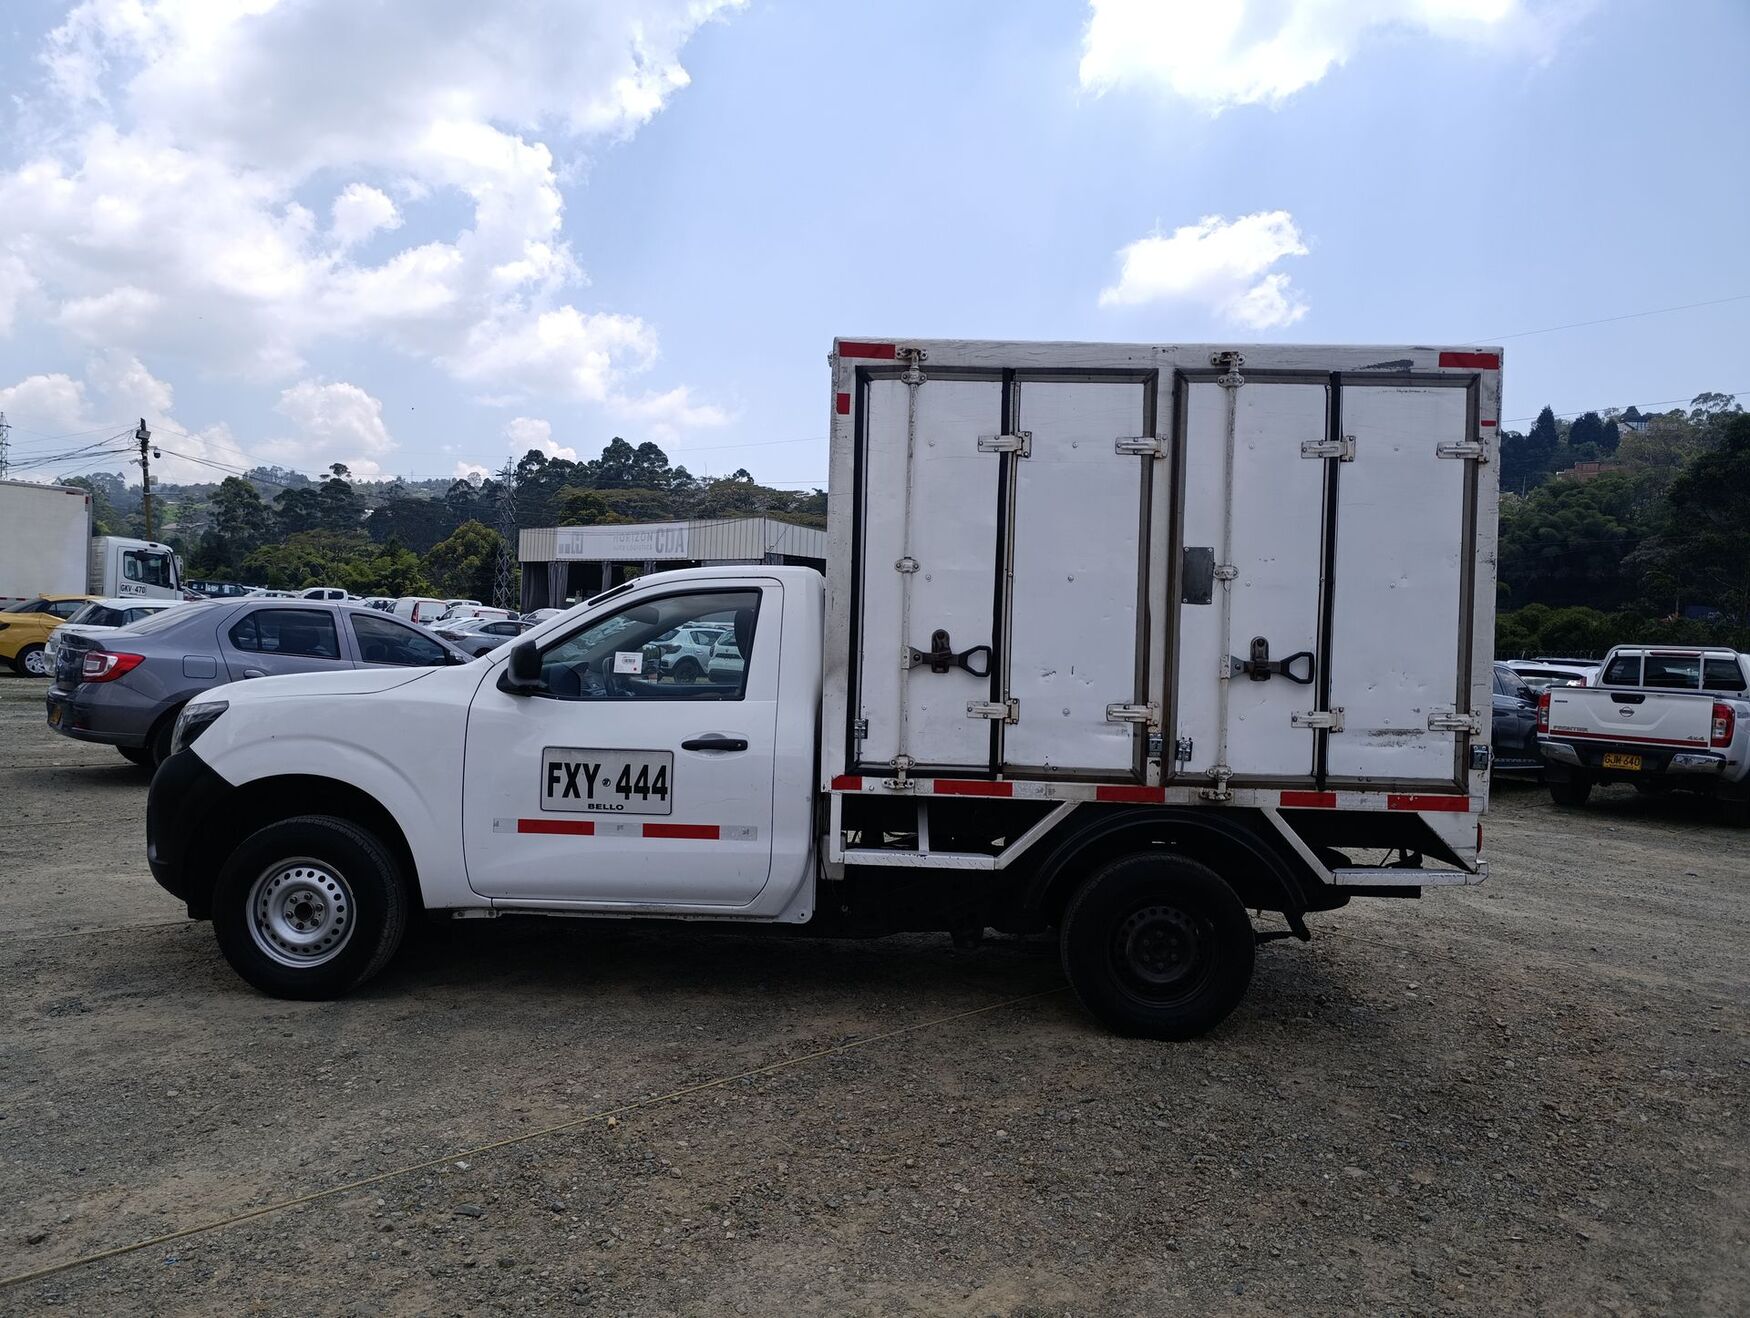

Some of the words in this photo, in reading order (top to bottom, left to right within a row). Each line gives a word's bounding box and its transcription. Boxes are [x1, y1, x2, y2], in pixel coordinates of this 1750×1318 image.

[547, 762, 601, 799] FXY
[615, 764, 668, 801] 444
[588, 803, 624, 811] BELLO
